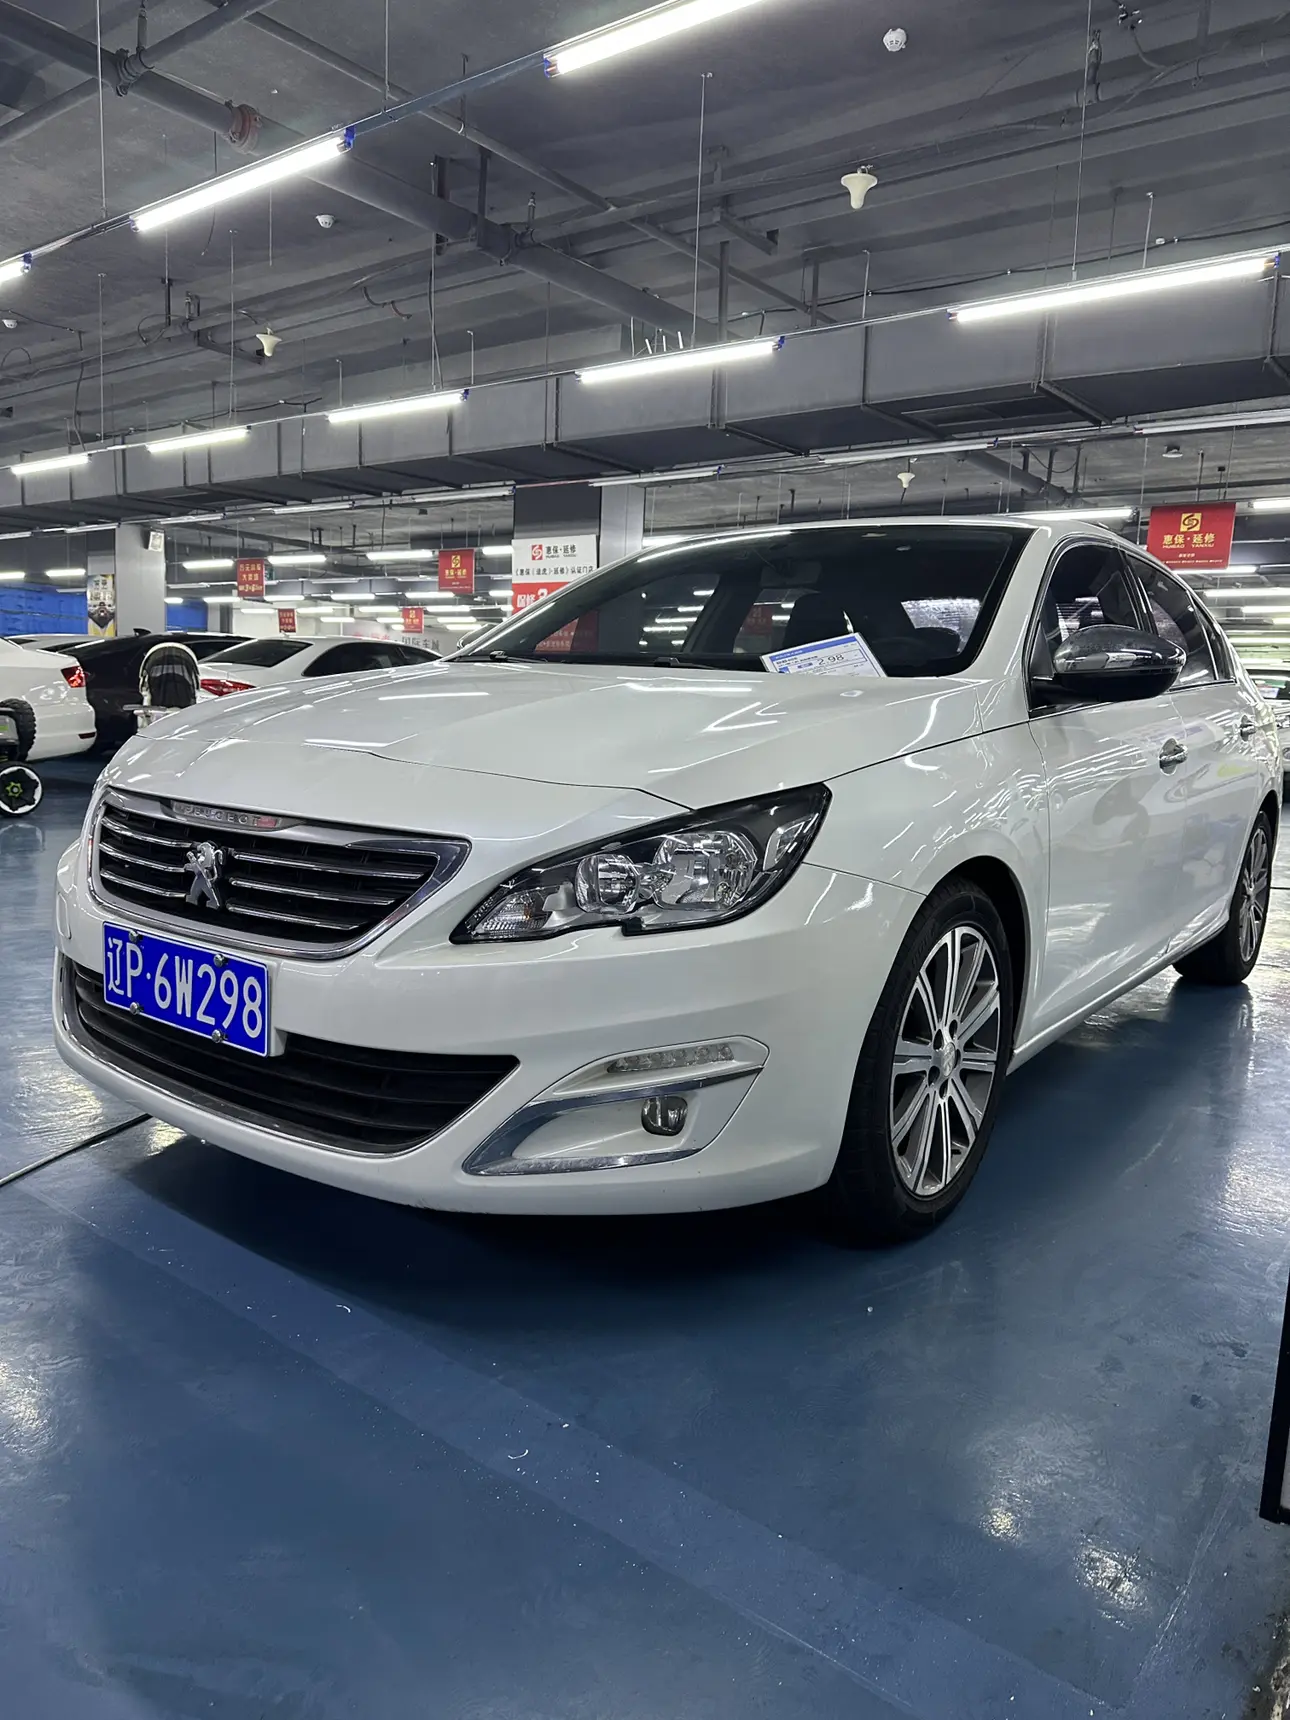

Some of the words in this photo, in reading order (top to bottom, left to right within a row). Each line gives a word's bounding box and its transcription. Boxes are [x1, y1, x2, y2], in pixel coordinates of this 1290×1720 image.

[1162, 533, 1215, 545] 惠保·延修
[545, 544, 576, 555] 惠保·延修
[818, 653, 844, 666] 2.98
[107, 936, 263, 1039] 辽P·6W298
